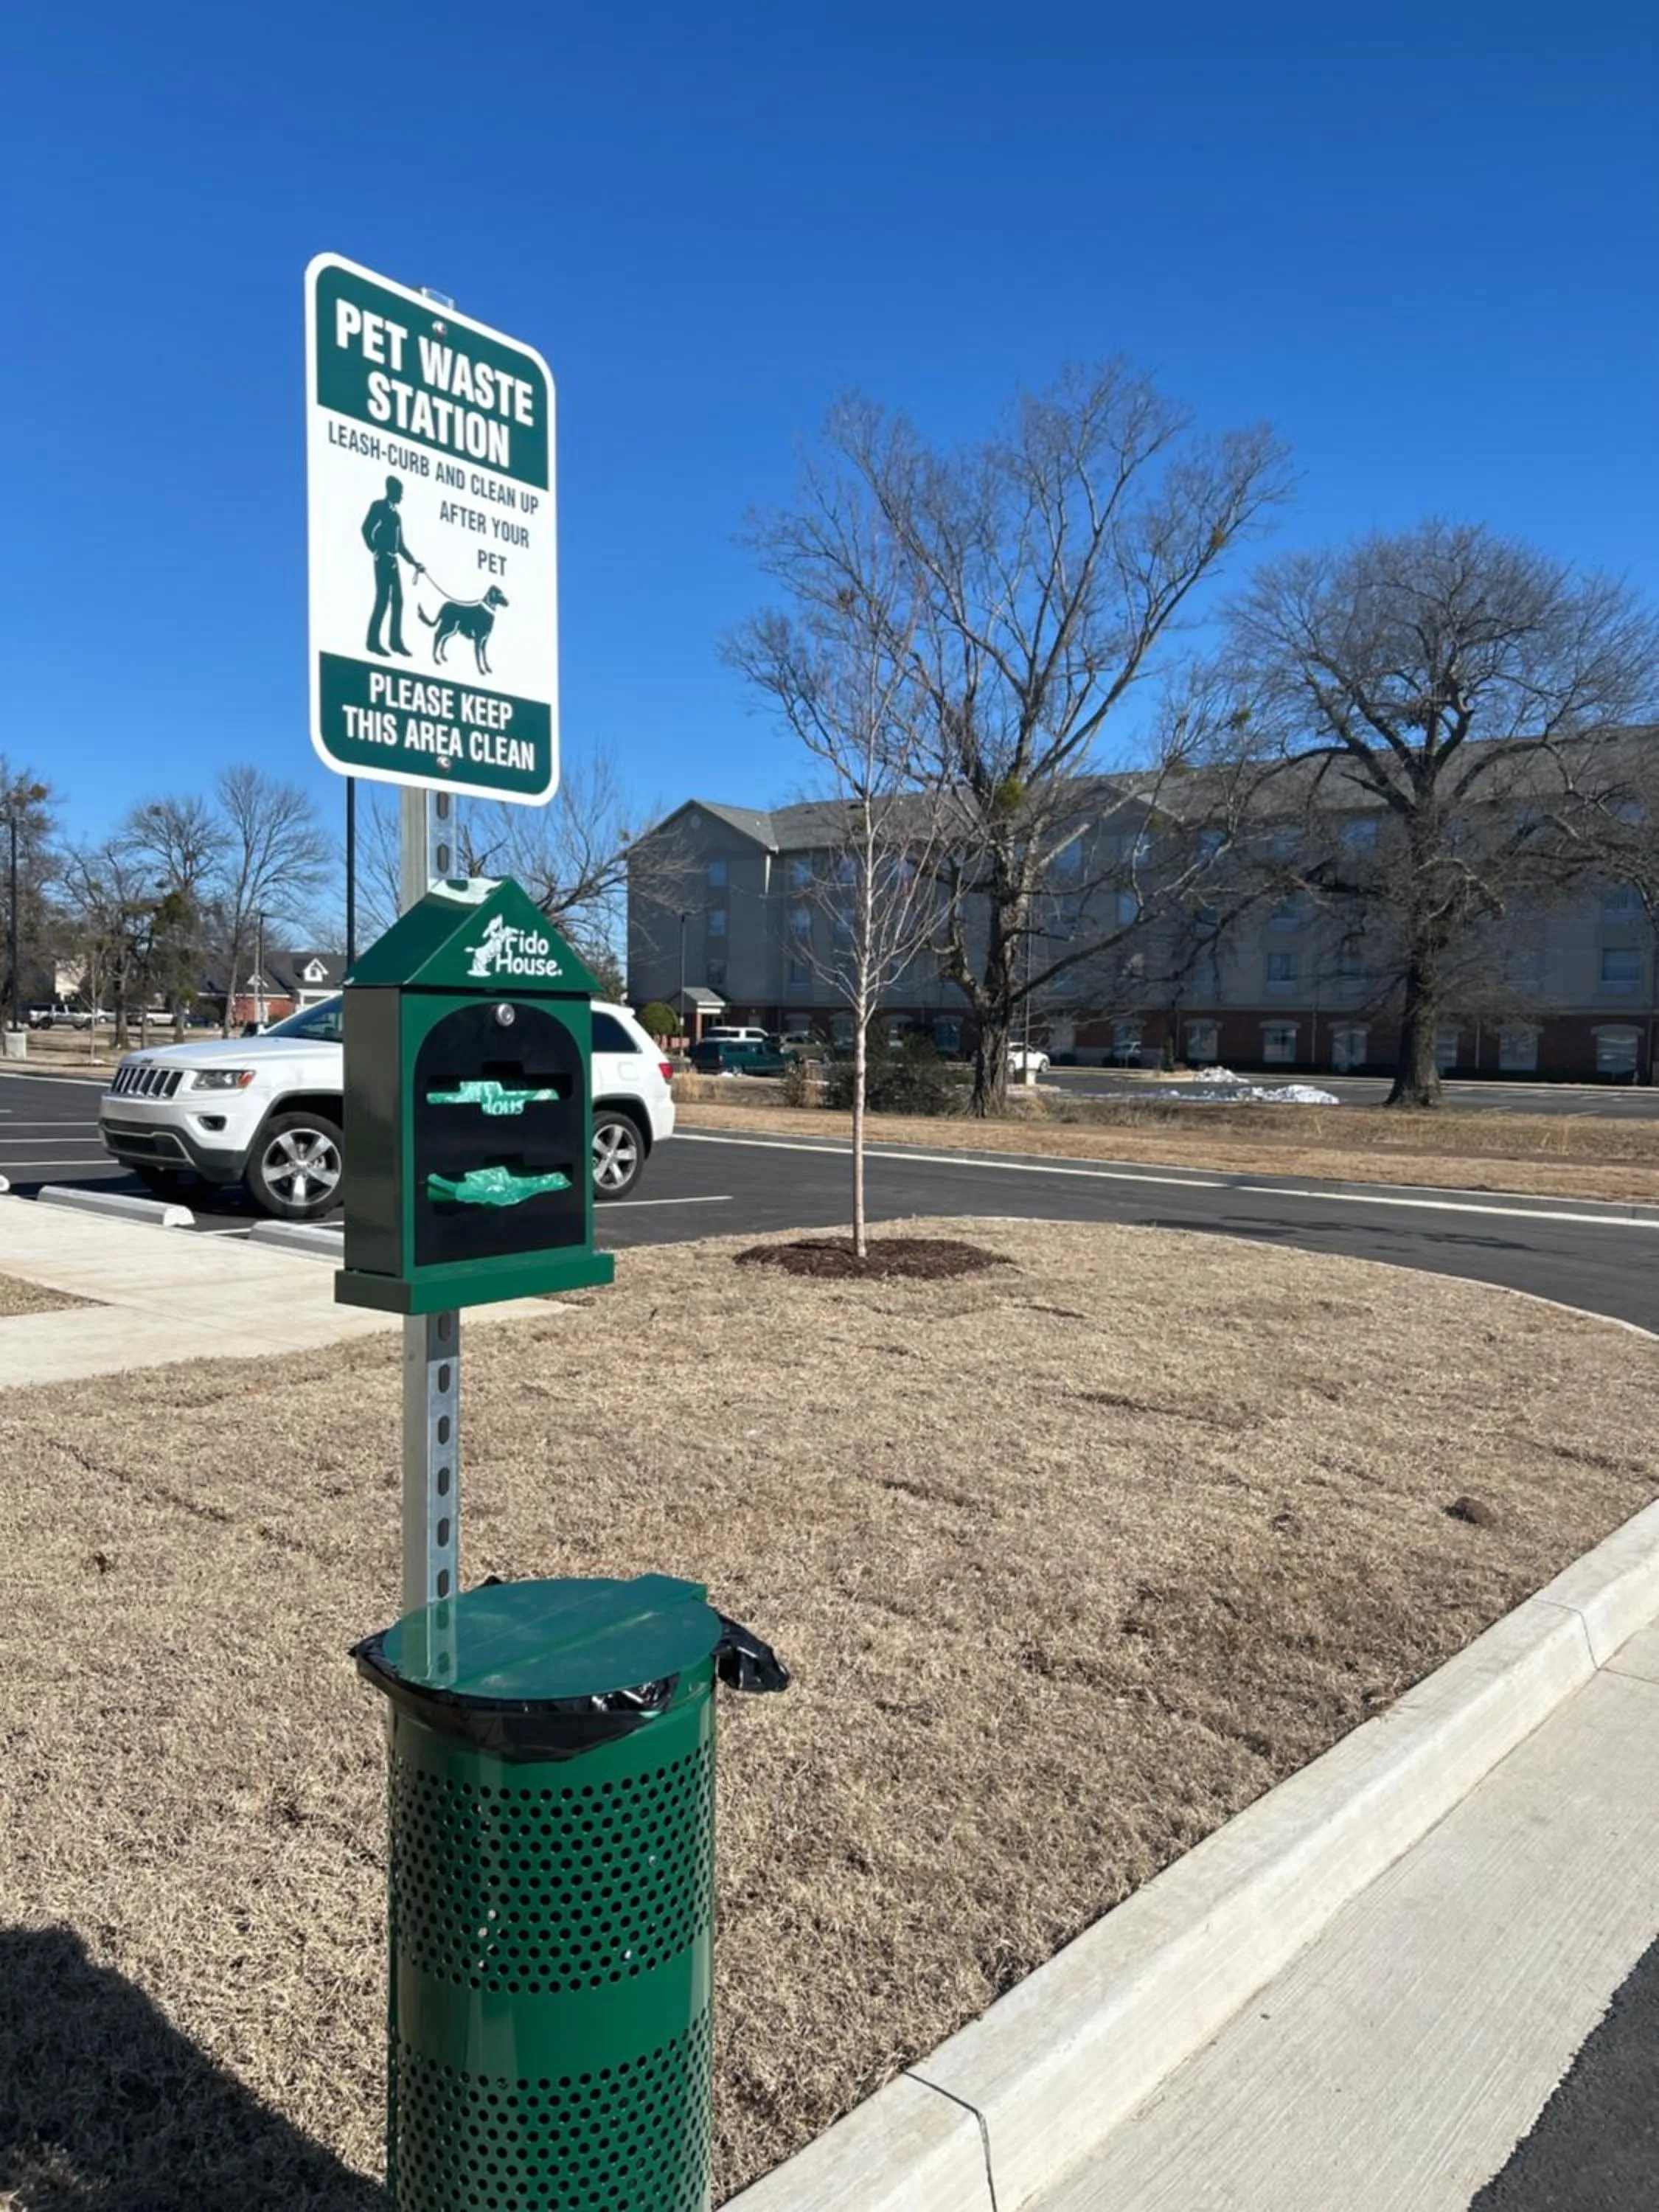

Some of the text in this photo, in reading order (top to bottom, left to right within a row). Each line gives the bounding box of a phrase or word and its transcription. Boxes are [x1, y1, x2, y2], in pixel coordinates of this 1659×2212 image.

[336, 298, 534, 427] PET WASTE
[367, 371, 509, 468] STATION
[328, 420, 539, 515] LEASH-CURB AND CLEAN UP
[439, 501, 529, 549] AFTER YOUR
[477, 549, 507, 577] PET
[369, 672, 513, 730] PLEASE KEEP
[342, 704, 535, 772] THIS AREA CLEAN
[504, 926, 549, 956] Fido
